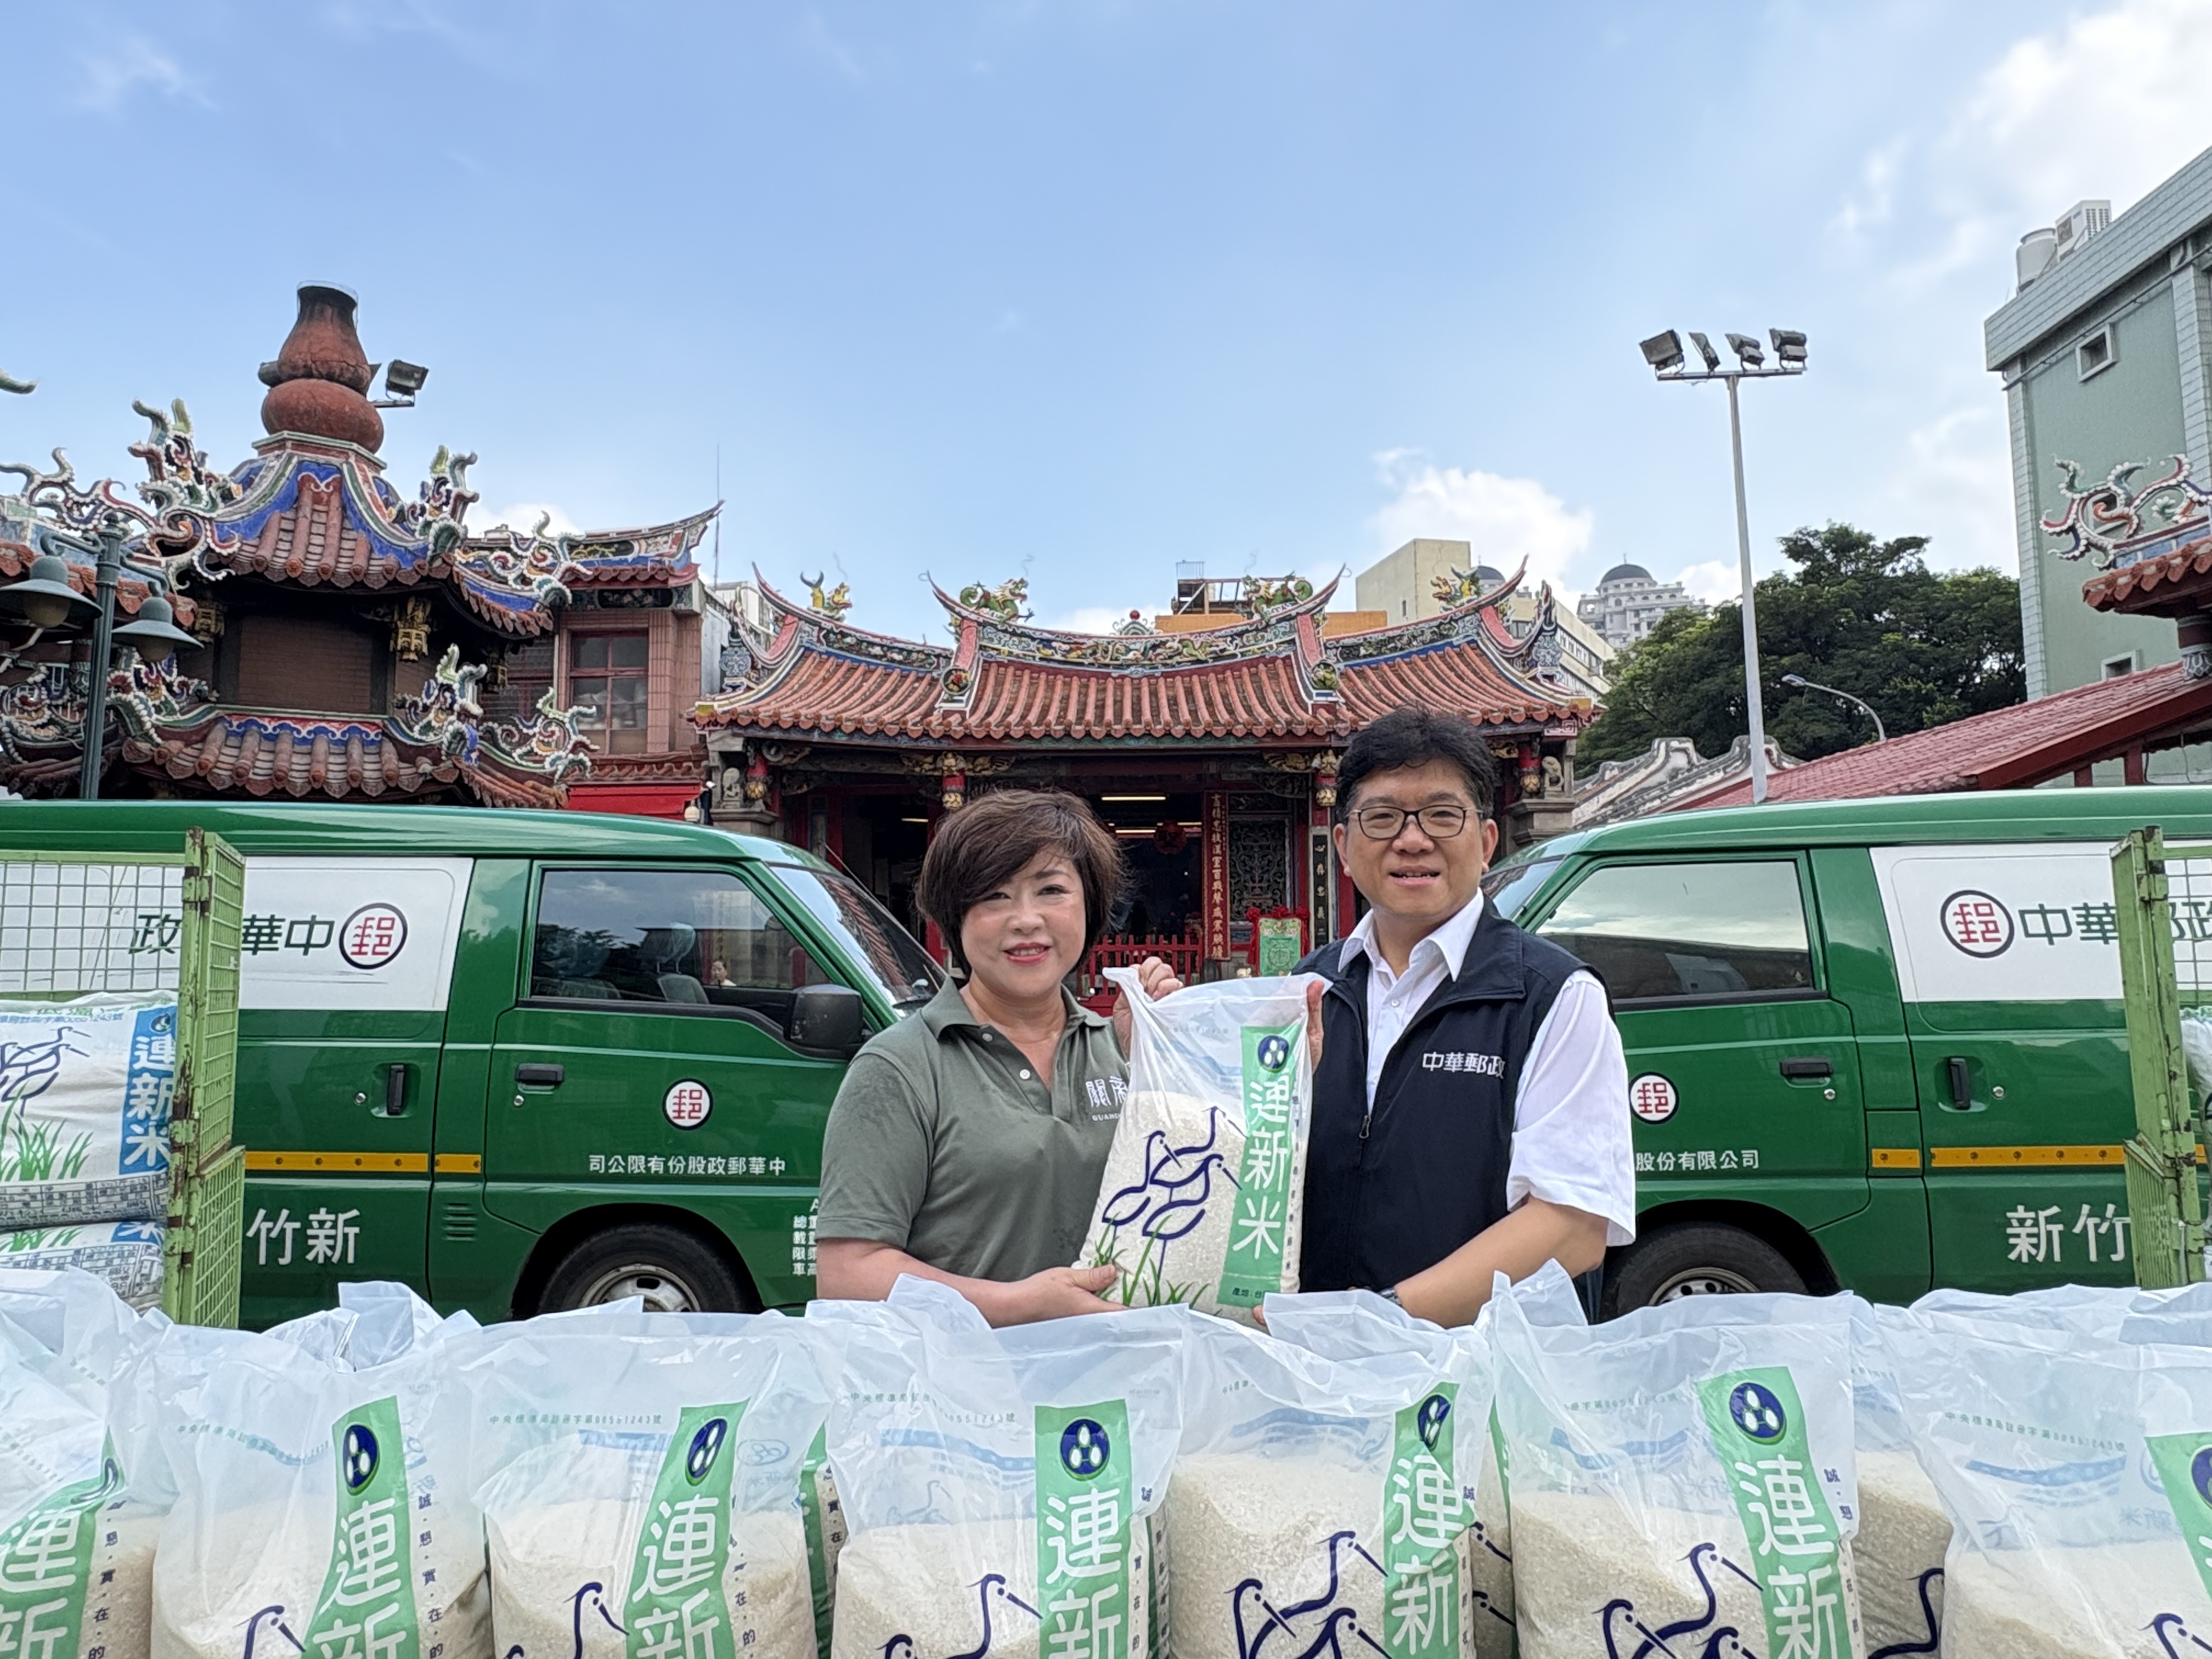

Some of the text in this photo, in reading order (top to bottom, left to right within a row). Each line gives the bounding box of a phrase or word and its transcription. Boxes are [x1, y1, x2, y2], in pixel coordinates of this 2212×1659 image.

[1422, 1052, 1505, 1079] 中華郵政
[1635, 1149, 1759, 1171] 股份有限公司
[2005, 1204, 2131, 1263] 新竹
